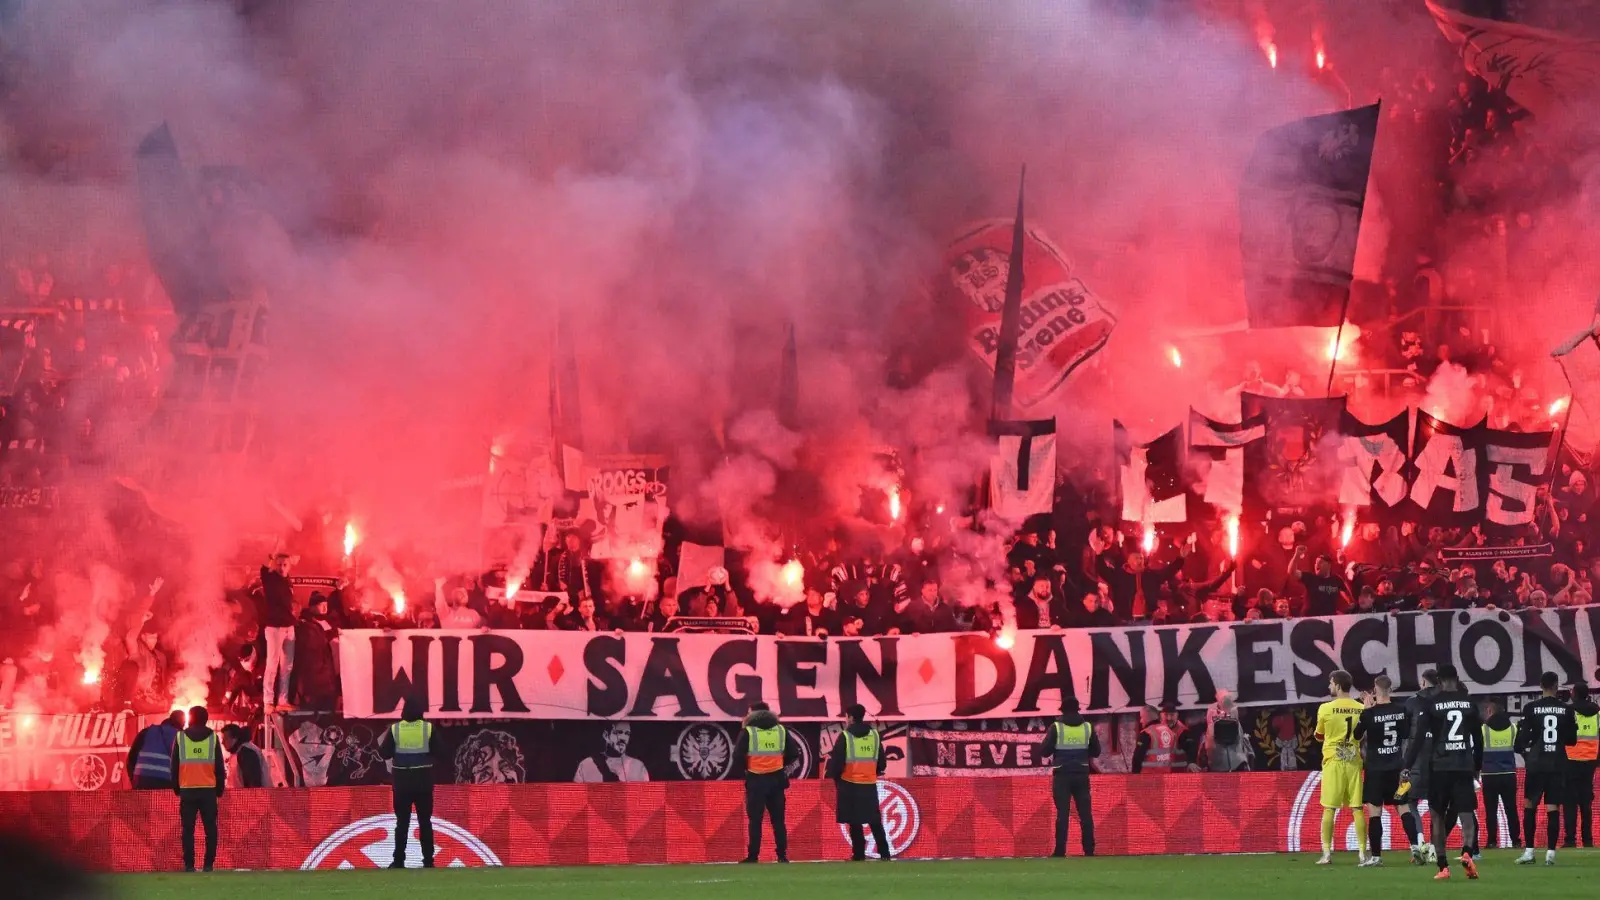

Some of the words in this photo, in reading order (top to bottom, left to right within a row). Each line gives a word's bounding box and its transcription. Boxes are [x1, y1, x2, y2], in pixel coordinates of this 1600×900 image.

[974, 286, 1086, 355] Bding
[369, 634, 532, 714] WIR
[582, 635, 906, 718] SAGEN
[1435, 700, 1471, 711] FRANKFURT
[1533, 706, 1566, 715] FRANKFURT
[46, 711, 127, 748] FULDA
[1345, 715, 1353, 742] 1
[1383, 721, 1398, 747] 5
[1446, 710, 1464, 741] 2
[1543, 714, 1558, 744] 8
[1544, 744, 1556, 752] SOW
[110, 761, 125, 784] 6
